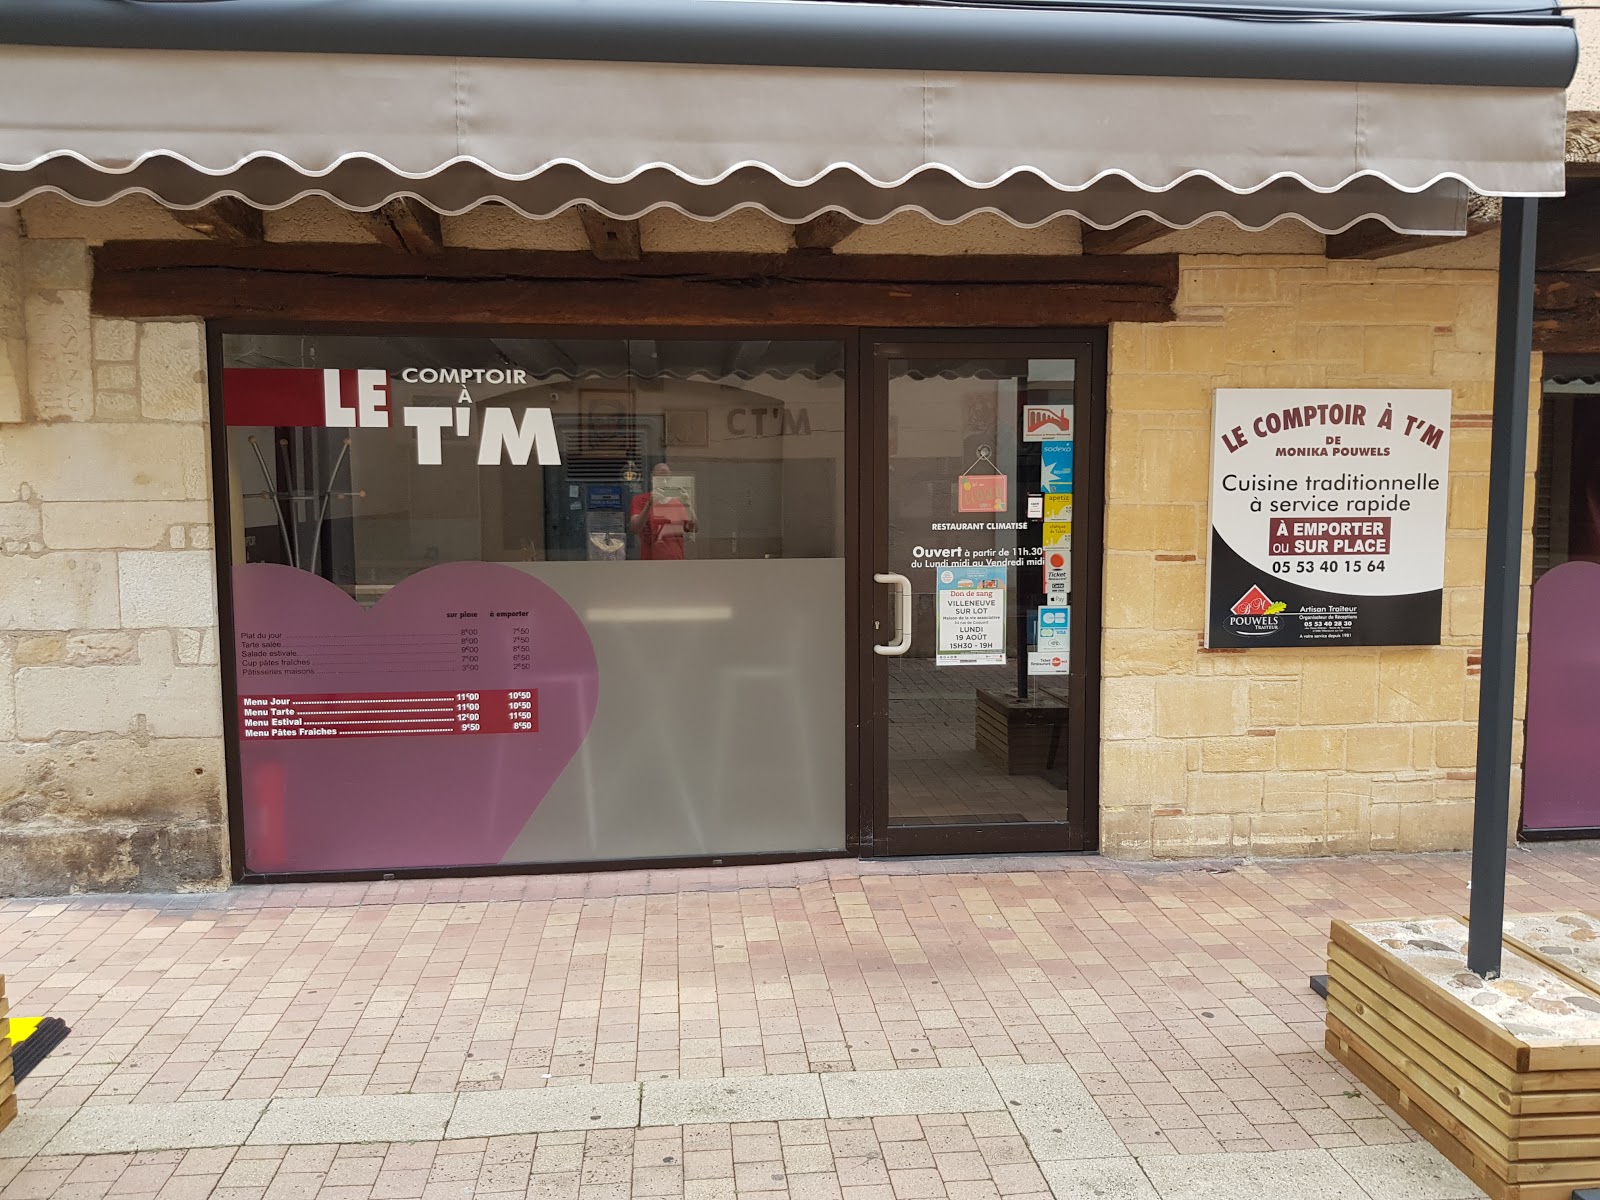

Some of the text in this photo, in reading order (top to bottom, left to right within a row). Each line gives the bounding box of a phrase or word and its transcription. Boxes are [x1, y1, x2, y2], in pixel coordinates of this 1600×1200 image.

[402, 368, 527, 386] COMPTOIR
[323, 369, 388, 428] LE
[458, 385, 473, 404] À
[1221, 403, 1444, 453] LE COMPTOIR À T'M
[404, 407, 562, 466] T'M
[1325, 436, 1341, 445] DE
[1044, 443, 1071, 452] sodexo
[1275, 447, 1391, 457] MONIKA POUWELS
[1222, 473, 1440, 491] Cuisine traditionnelle
[1049, 494, 1070, 502] apetiz
[1250, 494, 1411, 515] à service rapide
[932, 522, 984, 531] RESTAURANT
[1277, 520, 1384, 536] À EMPORTER
[912, 546, 962, 558] Ouvert
[964, 549, 970, 557] à
[972, 548, 997, 558] partir
[998, 548, 1010, 556] de
[1272, 539, 1386, 554] ou SUR PLACE
[911, 560, 923, 568] du
[925, 559, 948, 568] Lundi
[985, 558, 1024, 566] Vendredi
[1026, 557, 1045, 566] midi
[1272, 560, 1386, 573] 05 53 40 15 64
[460, 611, 478, 619] place
[1230, 616, 1278, 626] POUWELS
[259, 659, 279, 667] pâtes
[244, 698, 268, 706] Menu
[245, 729, 269, 737] Menu
